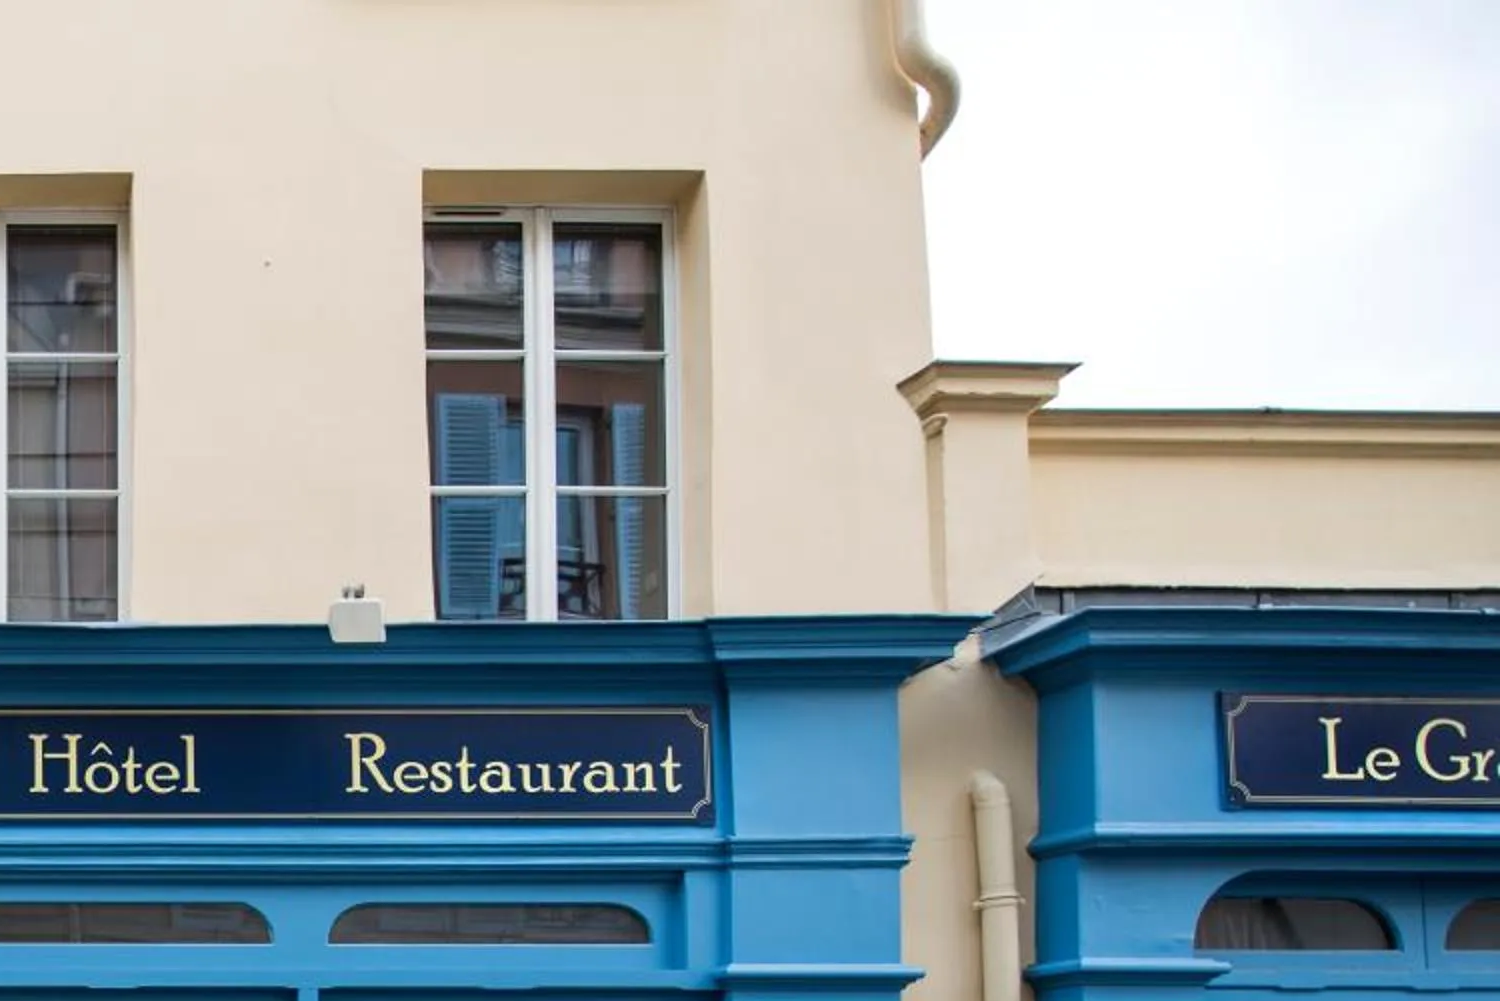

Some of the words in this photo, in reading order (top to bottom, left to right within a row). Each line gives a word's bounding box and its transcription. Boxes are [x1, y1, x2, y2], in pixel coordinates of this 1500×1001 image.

[28, 733, 201, 794] Hôtel
[344, 732, 683, 794] Restaurant
[1318, 716, 1401, 781] Le
[1415, 717, 1500, 782] Gr
